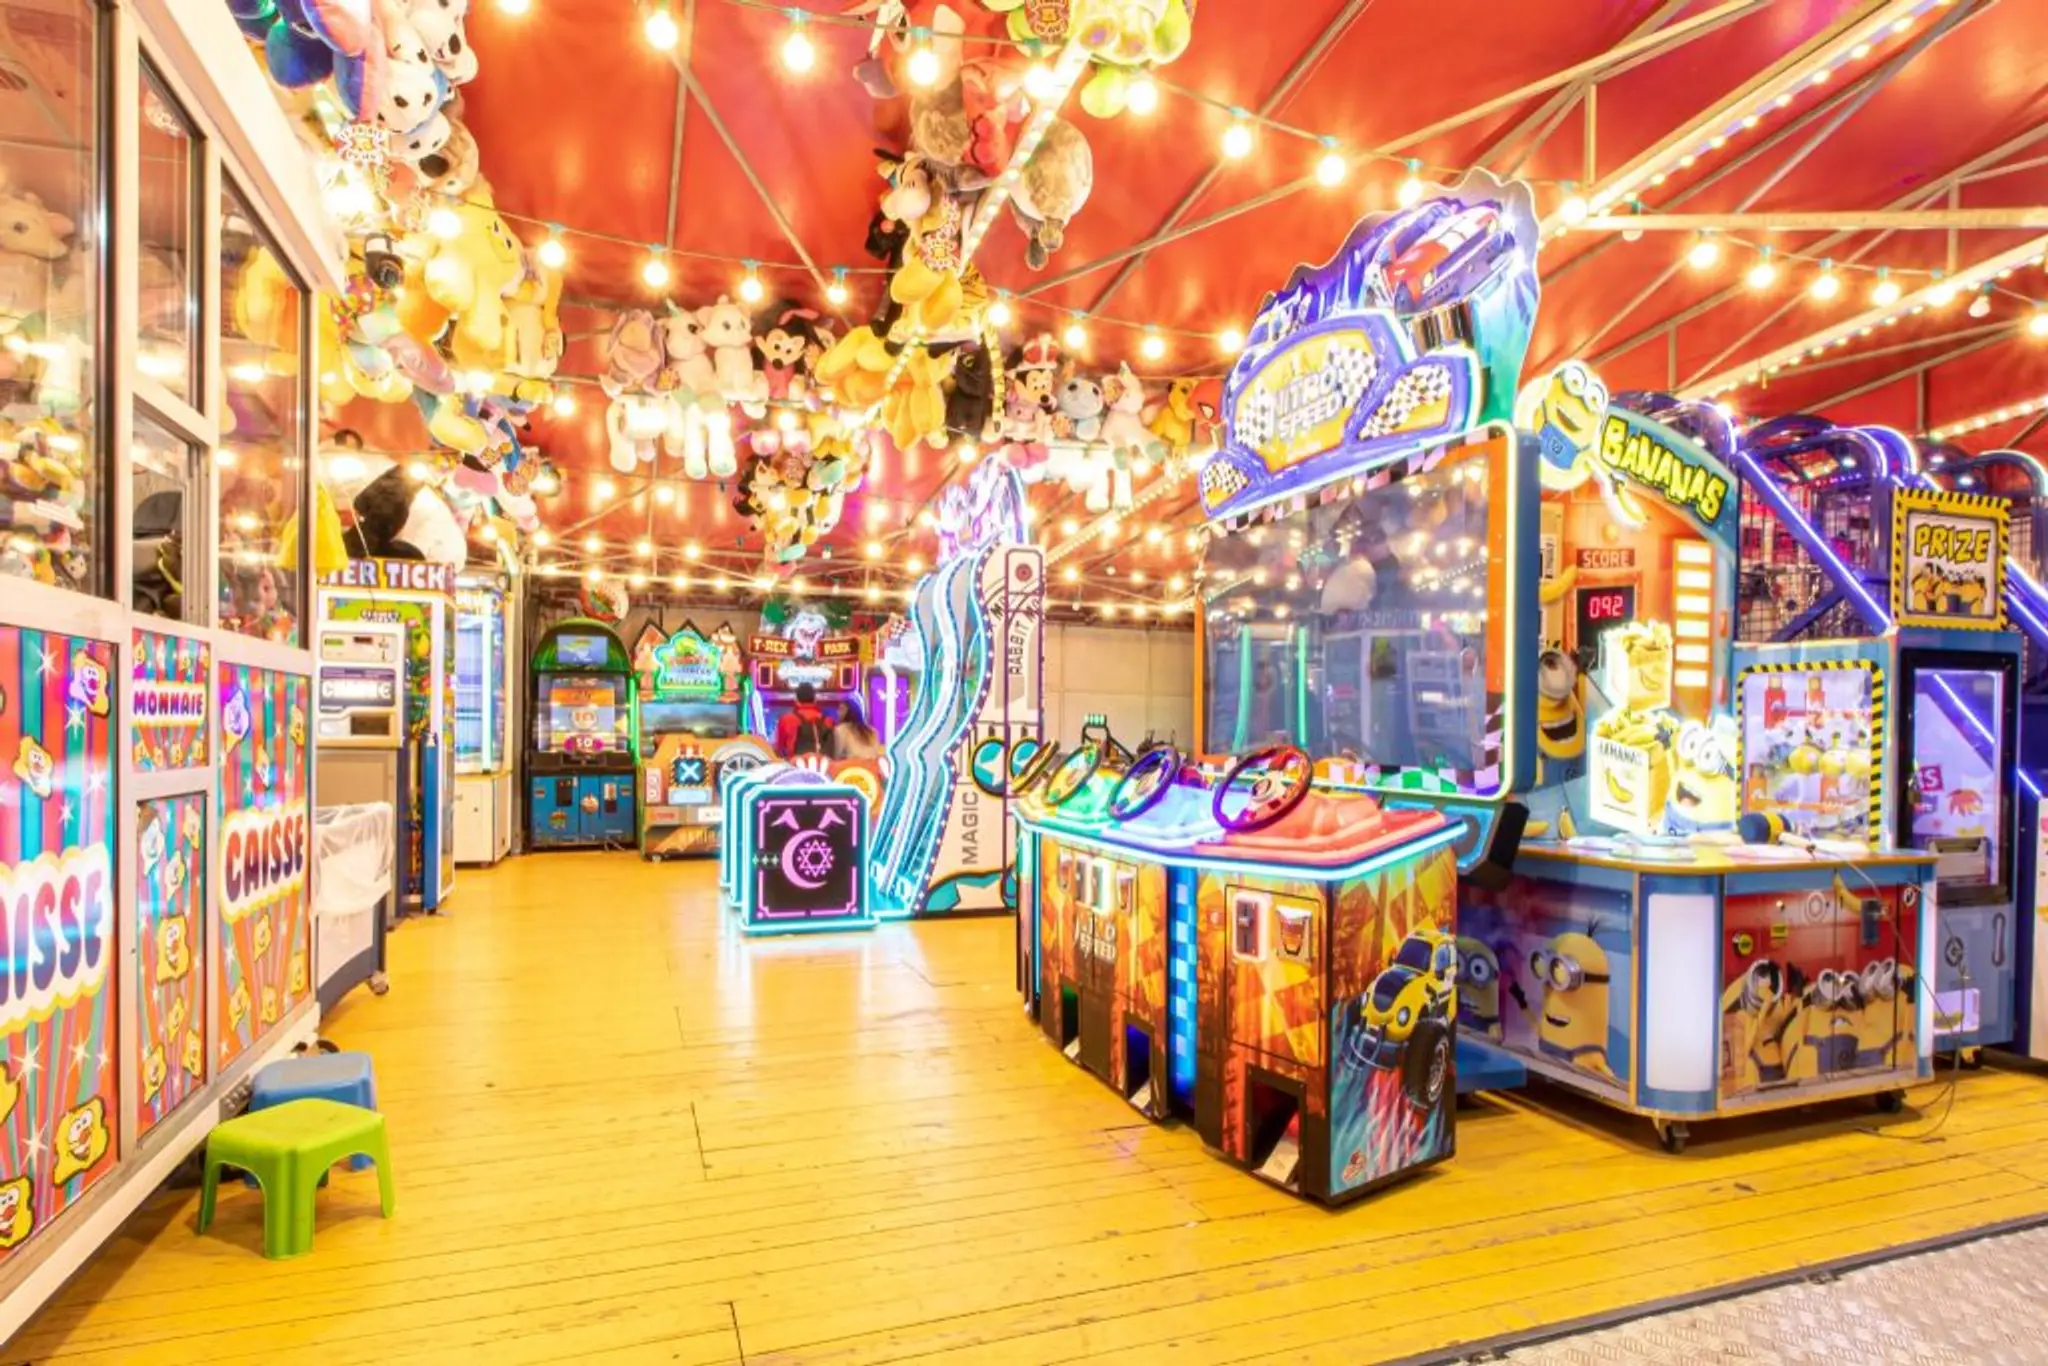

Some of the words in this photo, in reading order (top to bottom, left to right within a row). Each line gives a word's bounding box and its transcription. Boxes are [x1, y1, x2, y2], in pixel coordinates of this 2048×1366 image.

[1268, 364, 1341, 428] NITRO
[1277, 393, 1343, 440] SPEED
[1600, 416, 1729, 526] BANANAS
[1581, 550, 1631, 568] SCORE
[1913, 522, 1992, 565] PRIZE
[1589, 595, 1624, 619] 092
[752, 637, 789, 654] T-REX
[823, 643, 851, 656] PARK
[1008, 620, 1030, 675] RABBIT
[133, 689, 203, 716] MONNAIE
[962, 790, 980, 865] MAGIC
[226, 813, 304, 903] CAISSE
